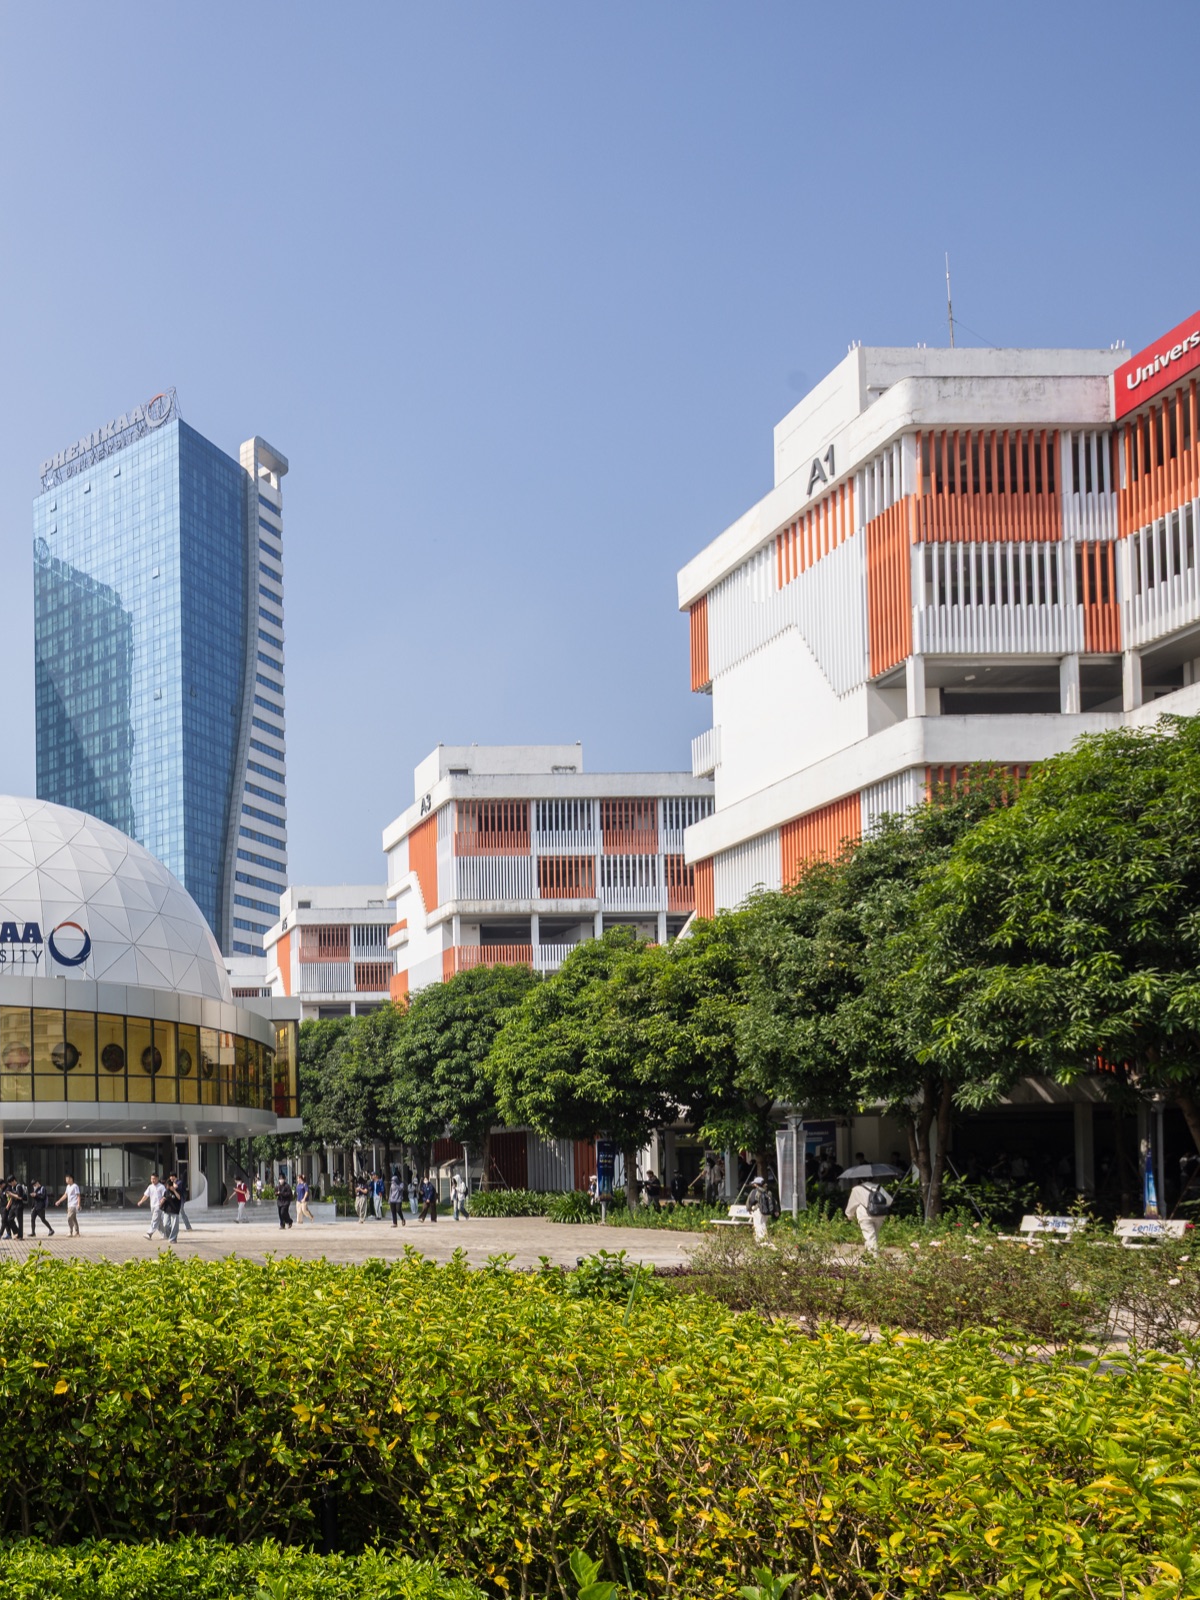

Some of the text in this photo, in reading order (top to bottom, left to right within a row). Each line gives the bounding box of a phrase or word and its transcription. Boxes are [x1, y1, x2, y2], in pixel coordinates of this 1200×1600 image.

[1126, 330, 1200, 390] Univers
[40, 403, 145, 478] PHENIKAA
[807, 444, 835, 496] A1
[420, 793, 432, 817] A3
